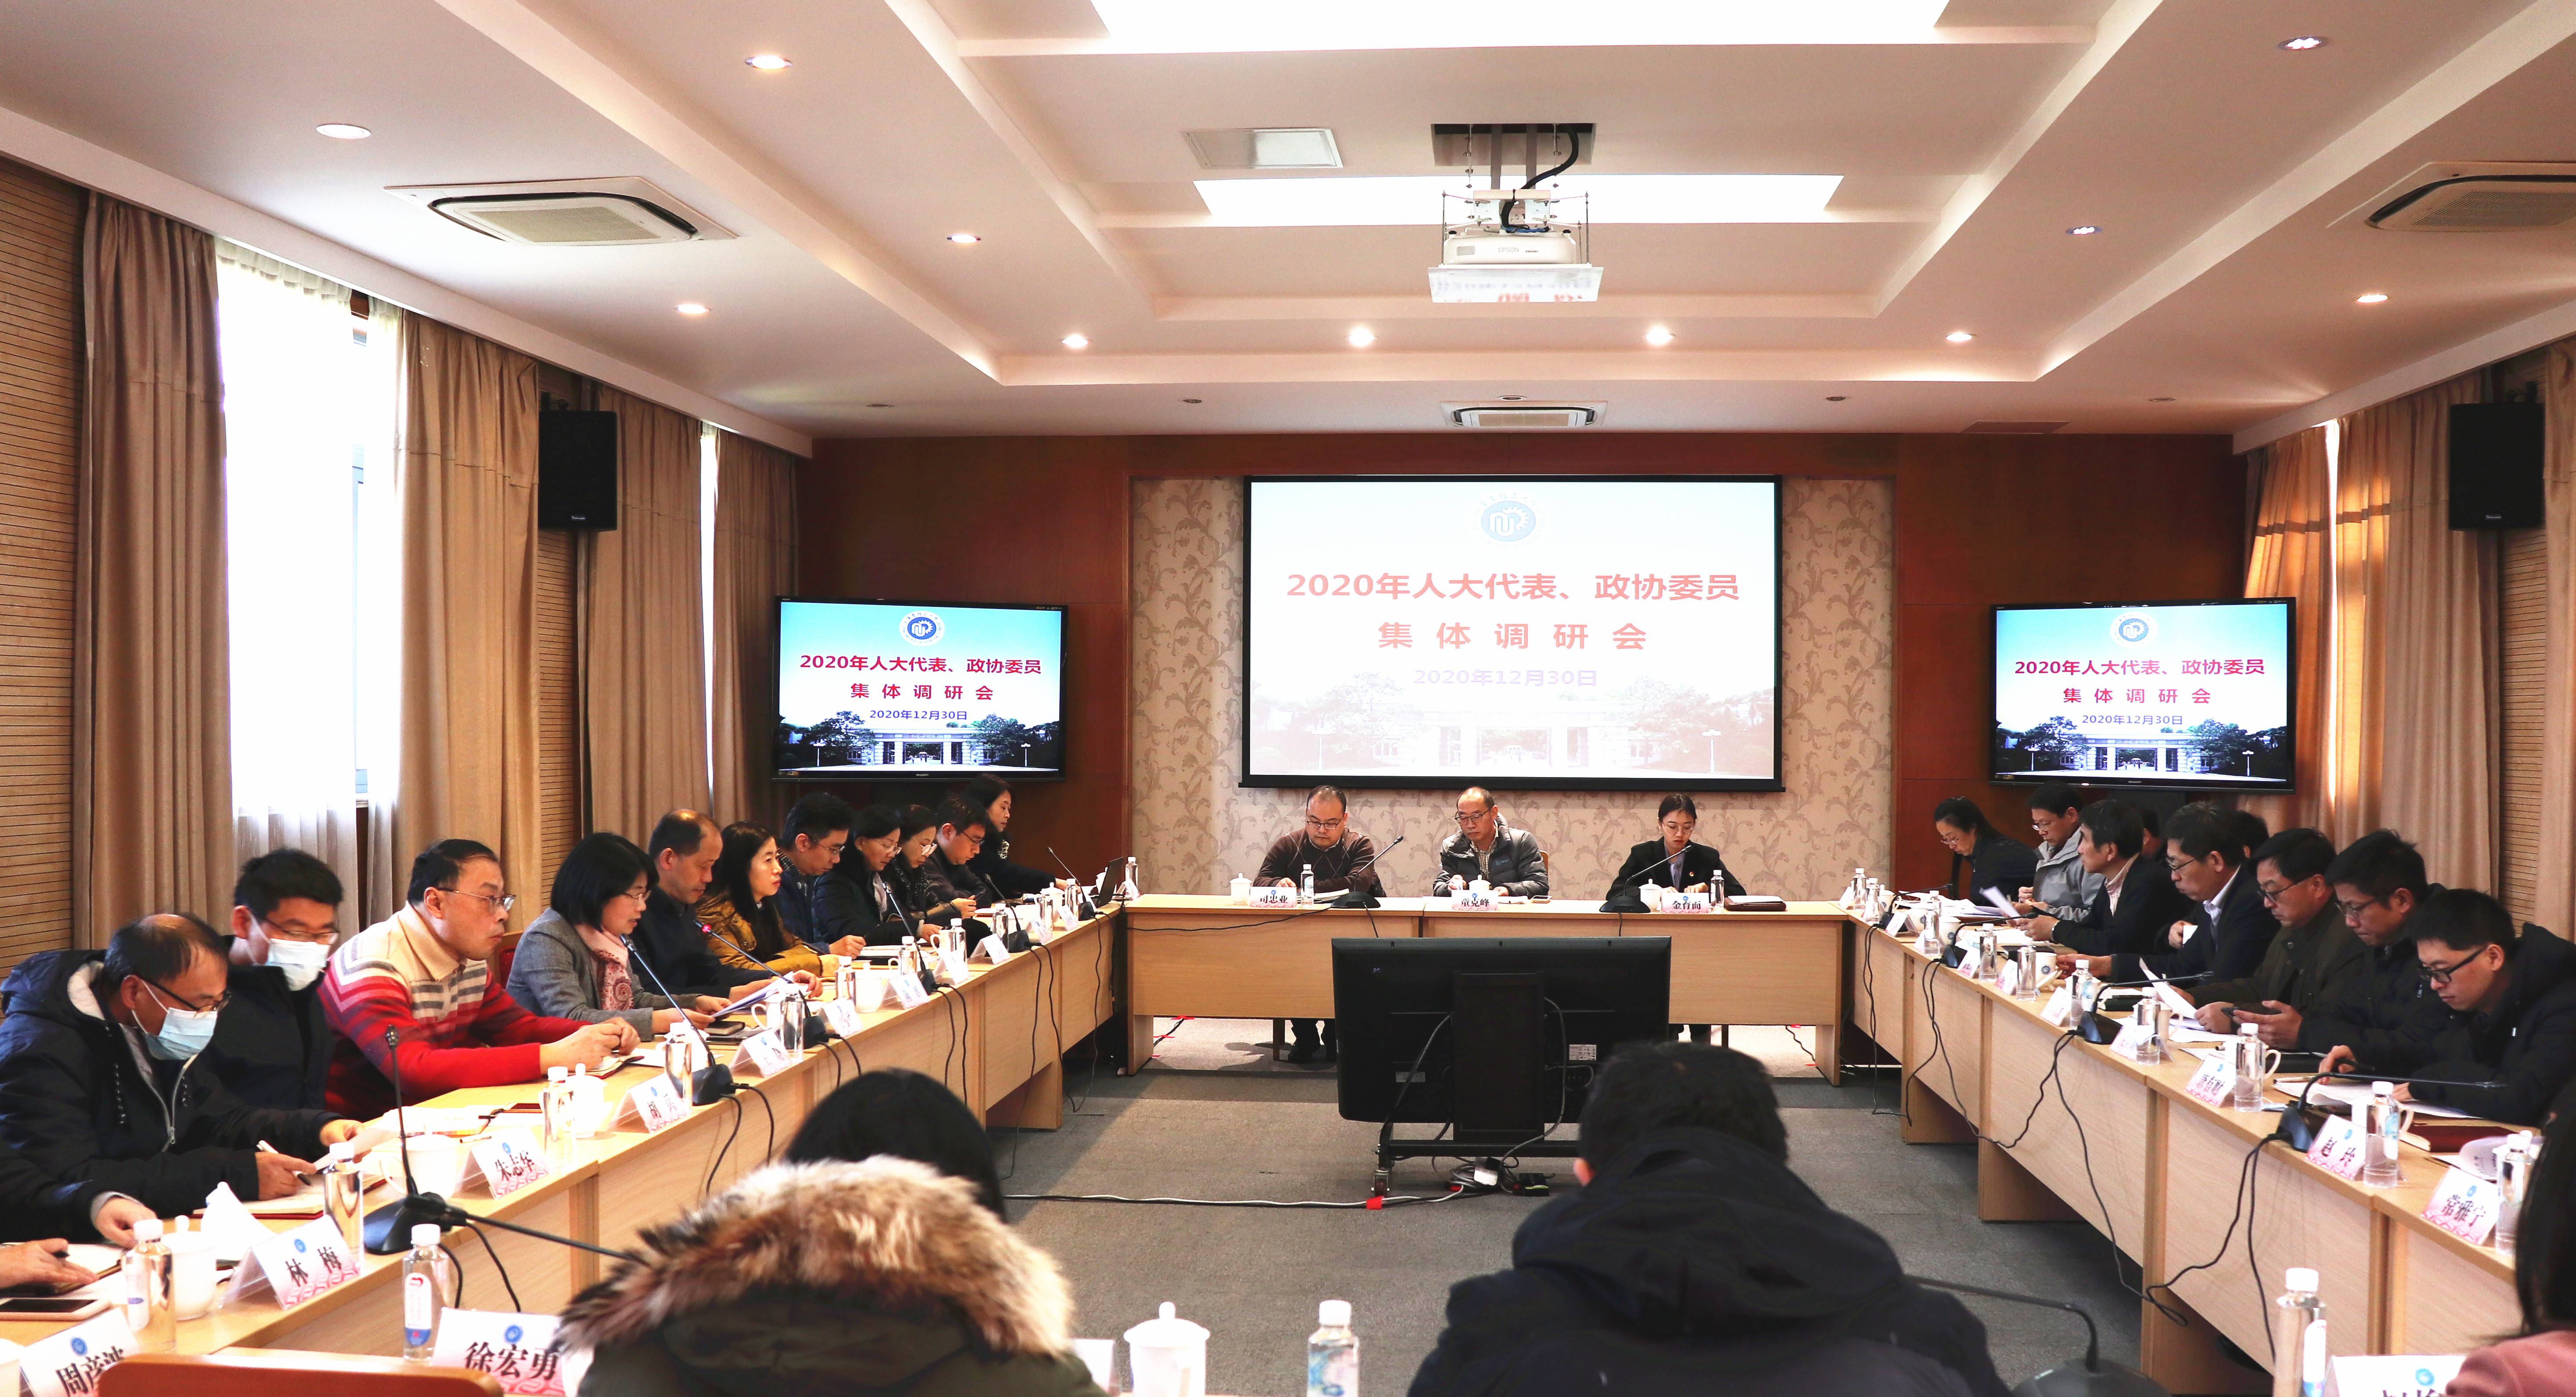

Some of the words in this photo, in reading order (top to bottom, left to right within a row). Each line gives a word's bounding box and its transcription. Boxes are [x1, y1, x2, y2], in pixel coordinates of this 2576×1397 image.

[1287, 573, 1740, 601] 2020年人大代表、政协委员
[1378, 622, 1646, 650] 集体调研会
[800, 655, 1041, 674] 2020年人大代表、政协委员
[2015, 659, 2265, 675] 2020年人大代表、政协委员
[1413, 669, 1597, 687] 2020年12月30日
[850, 683, 993, 700] 集体调研会
[2063, 688, 2211, 704] 集体调研会
[869, 710, 967, 720] 2020年12月30日
[2082, 715, 2183, 725] 2020年12月30日
[1259, 894, 1288, 904] 司忠业
[495, 1150, 535, 1181] 朱志华
[2441, 1194, 2486, 1226] 常雅宁
[285, 1246, 342, 1287] 林梅
[464, 1342, 559, 1381] 徐宏勇
